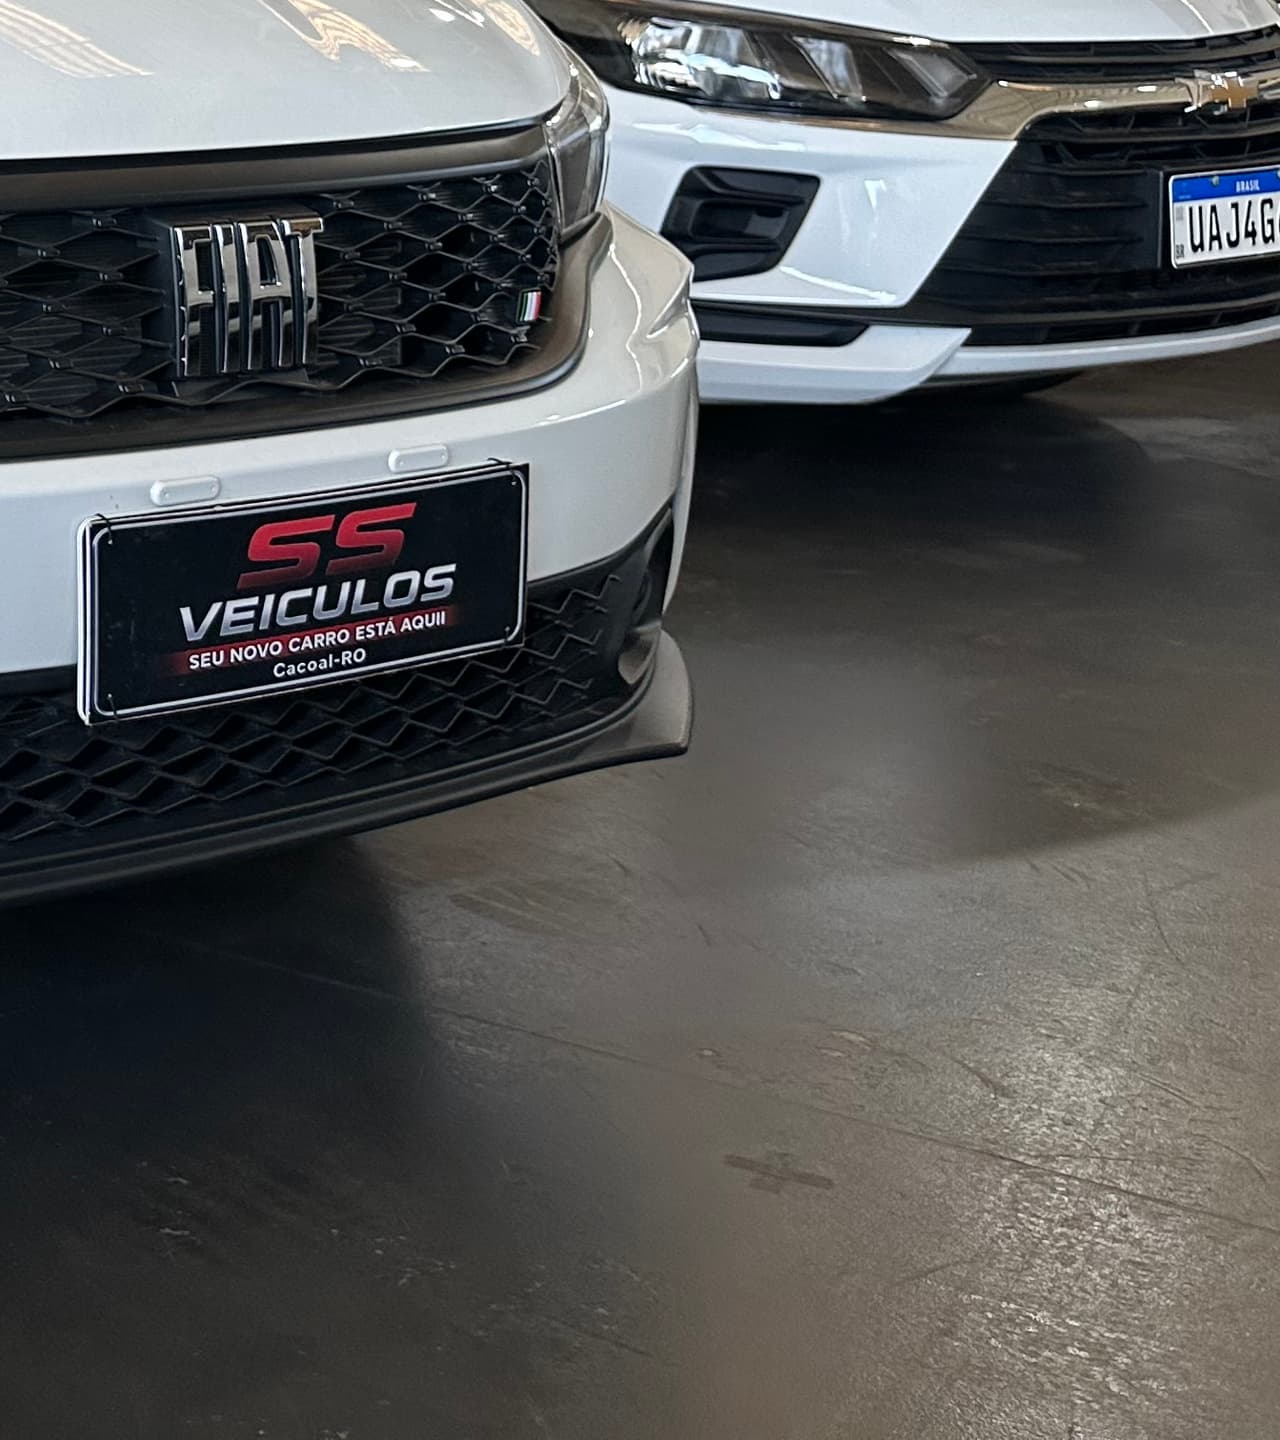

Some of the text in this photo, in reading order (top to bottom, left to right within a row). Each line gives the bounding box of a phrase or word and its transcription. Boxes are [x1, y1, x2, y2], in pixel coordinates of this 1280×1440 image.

[1236, 179, 1260, 192] BRASIL
[1189, 198, 1280, 253] UAJ4G
[176, 217, 324, 376] FIAT
[237, 504, 417, 589] SS
[179, 563, 457, 641] VEICULOS
[189, 650, 224, 669] SEU
[230, 642, 282, 662] NOVO
[288, 629, 350, 652] CARRO
[355, 617, 396, 640] ESTÁ
[273, 648, 366, 677] Cacoal-RO
